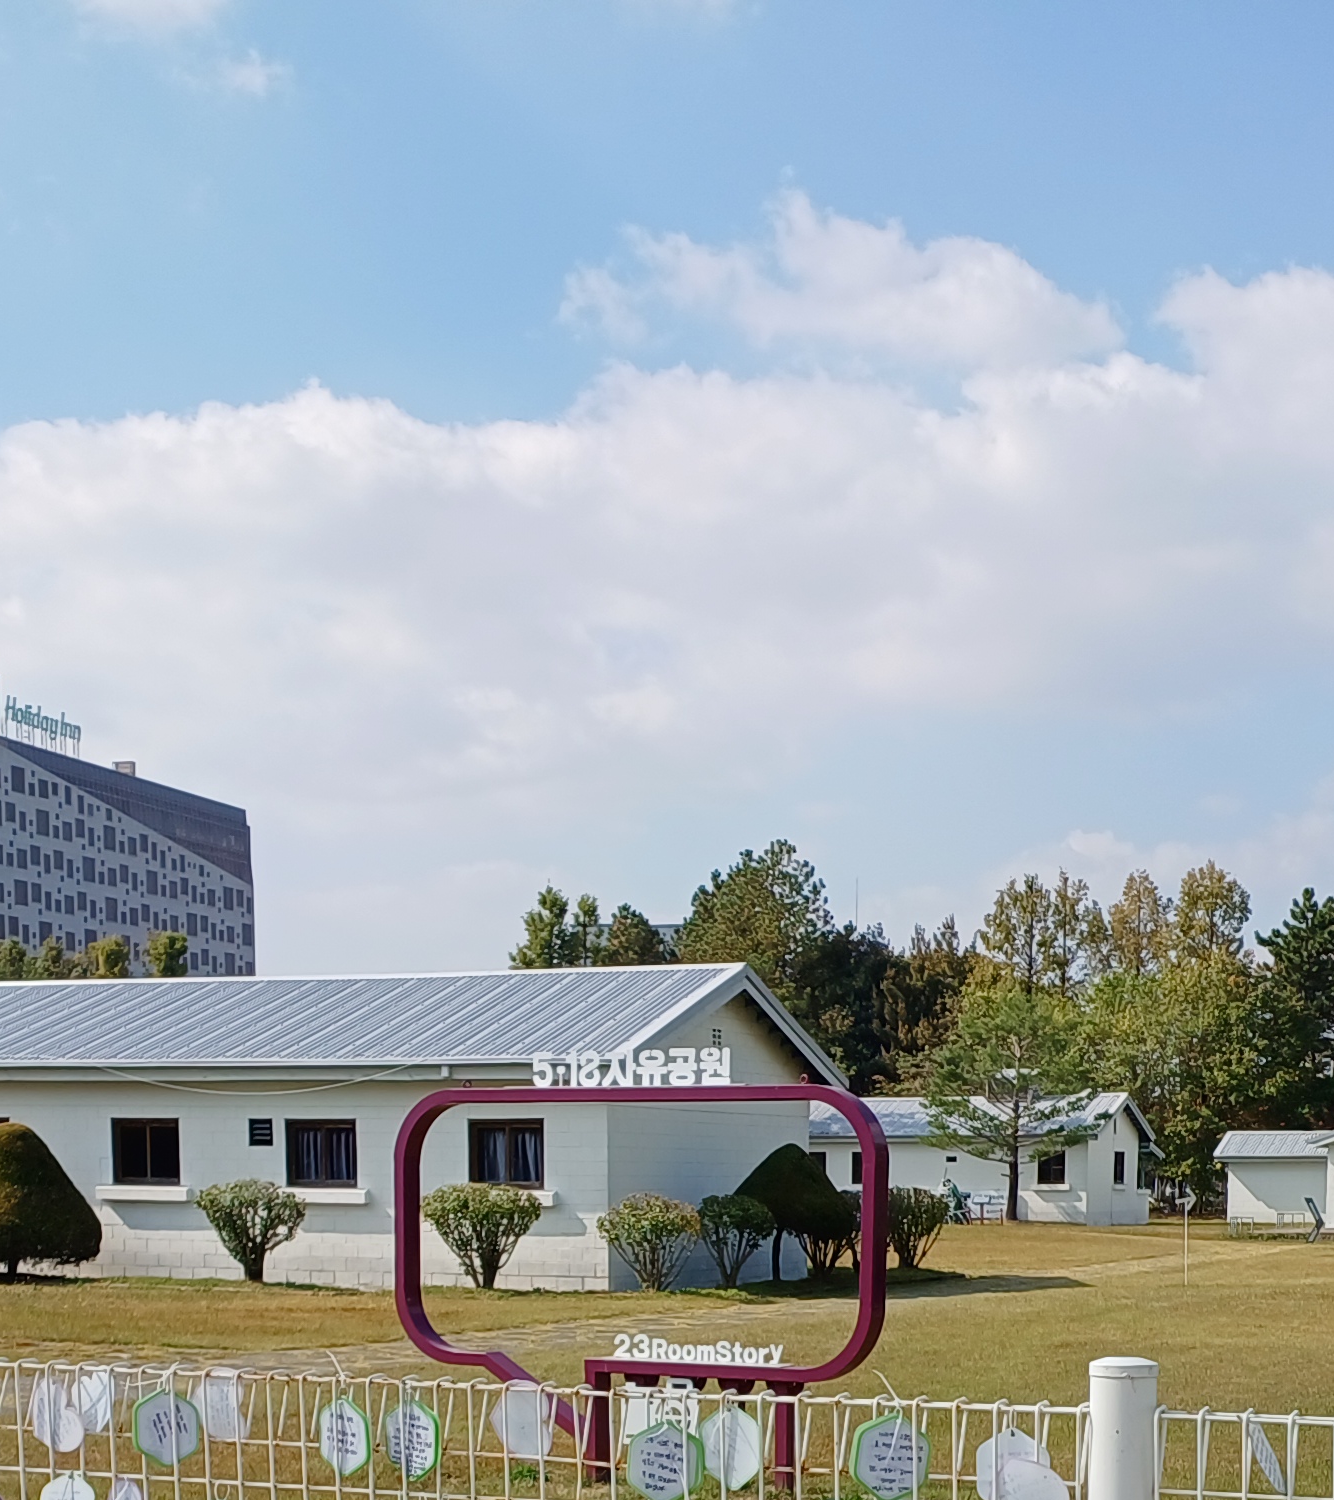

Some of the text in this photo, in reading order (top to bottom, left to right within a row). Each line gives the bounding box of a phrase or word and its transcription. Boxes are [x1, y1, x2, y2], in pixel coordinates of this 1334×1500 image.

[5, 695, 81, 741] Holiday Inn
[613, 1333, 784, 1365] 23RoomStory
